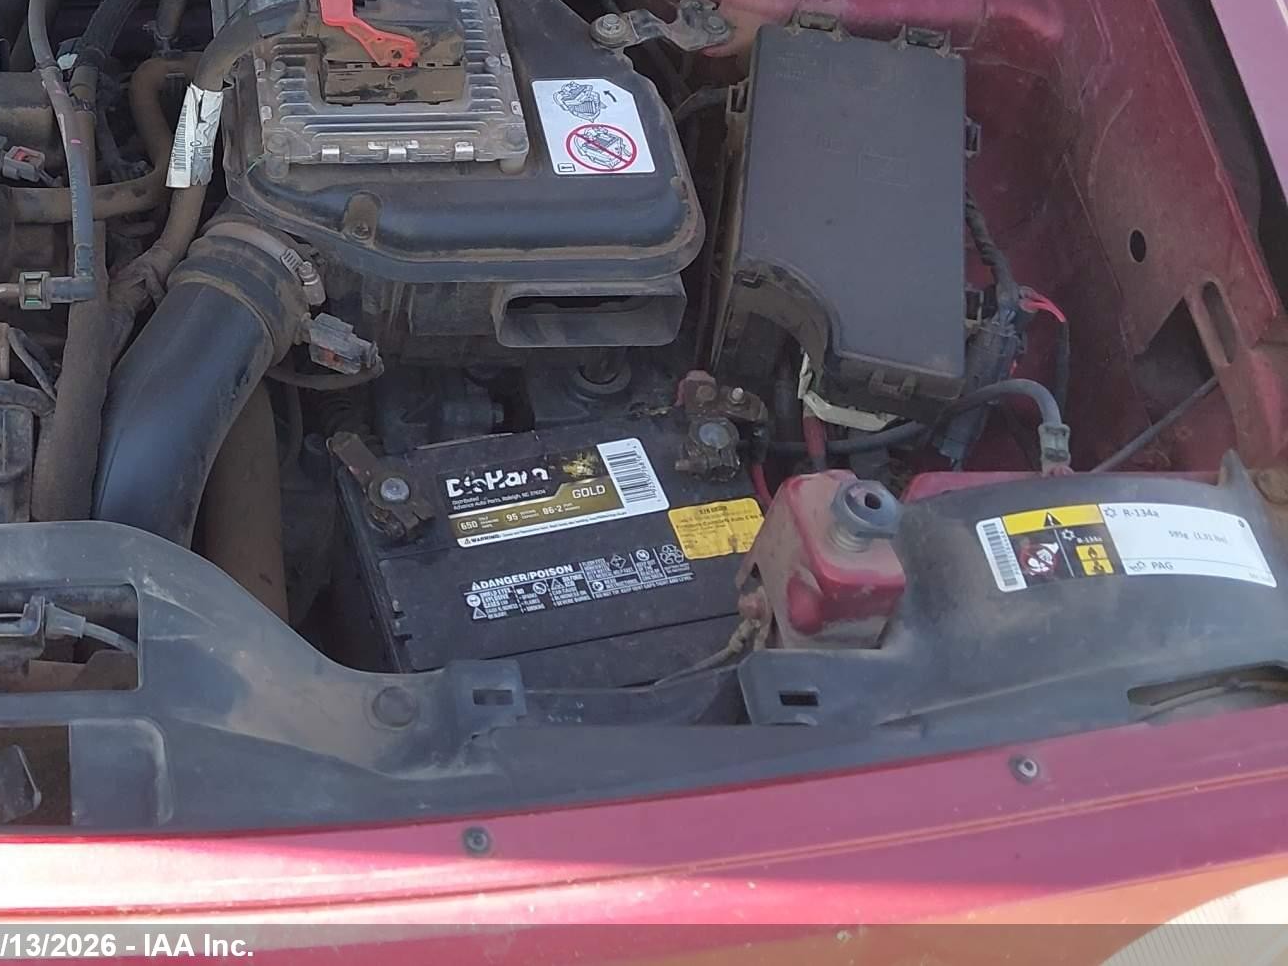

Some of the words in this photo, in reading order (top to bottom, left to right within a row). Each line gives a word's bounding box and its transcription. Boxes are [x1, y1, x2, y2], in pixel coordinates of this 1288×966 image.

[571, 484, 606, 499] GOLD
[506, 512, 519, 522] 95
[1122, 508, 1160, 519] R-134a
[461, 520, 478, 531] 650
[1151, 561, 1174, 571] PAG
[479, 564, 574, 589] DANGER/POISON
